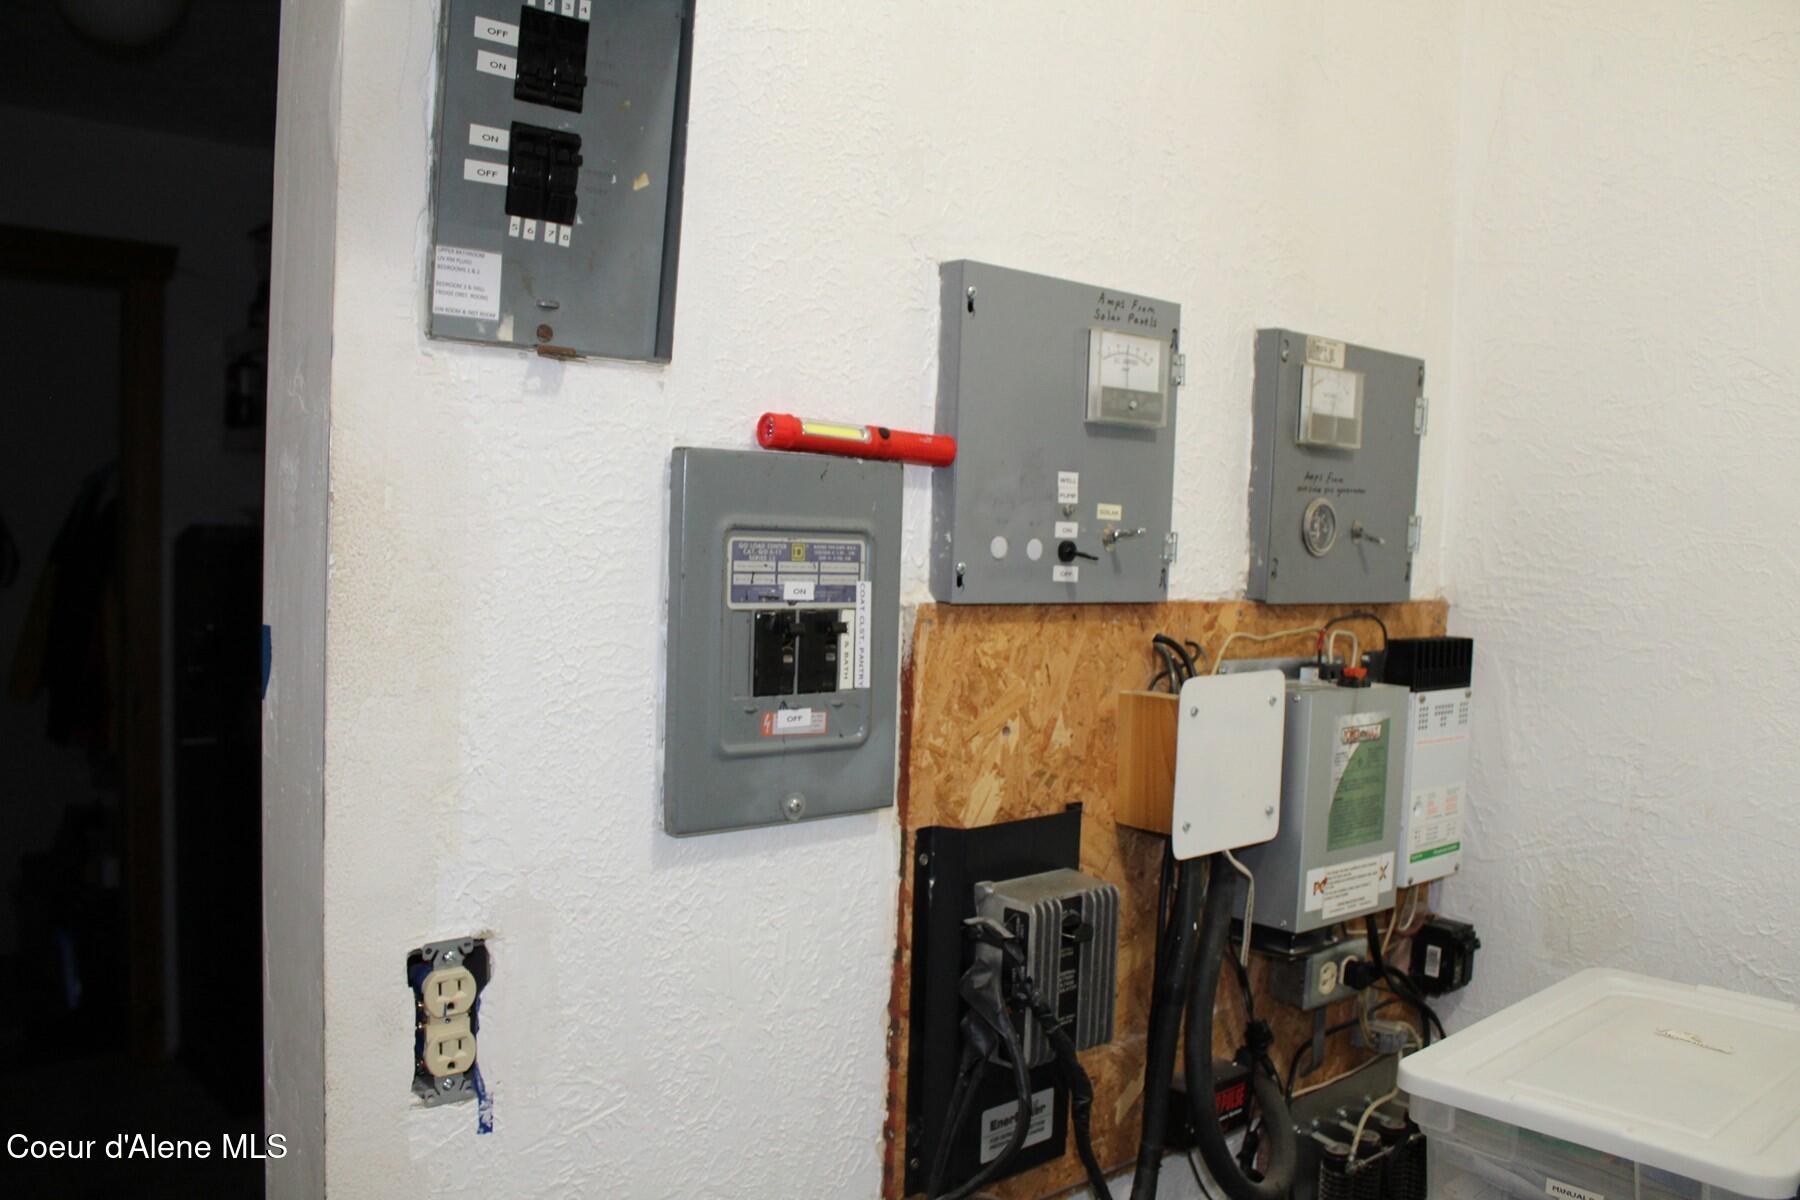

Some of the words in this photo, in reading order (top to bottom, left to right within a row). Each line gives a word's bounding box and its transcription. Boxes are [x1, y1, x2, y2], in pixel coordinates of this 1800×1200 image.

[487, 26, 509, 38] OFF
[489, 61, 507, 71] ON
[482, 133, 499, 143] ON
[476, 168, 498, 178] OFF
[1097, 292, 1125, 311] Amps
[1131, 299, 1156, 314] From
[1094, 307, 1121, 321] Solar
[792, 588, 807, 596] ON
[786, 715, 803, 723] OFF
